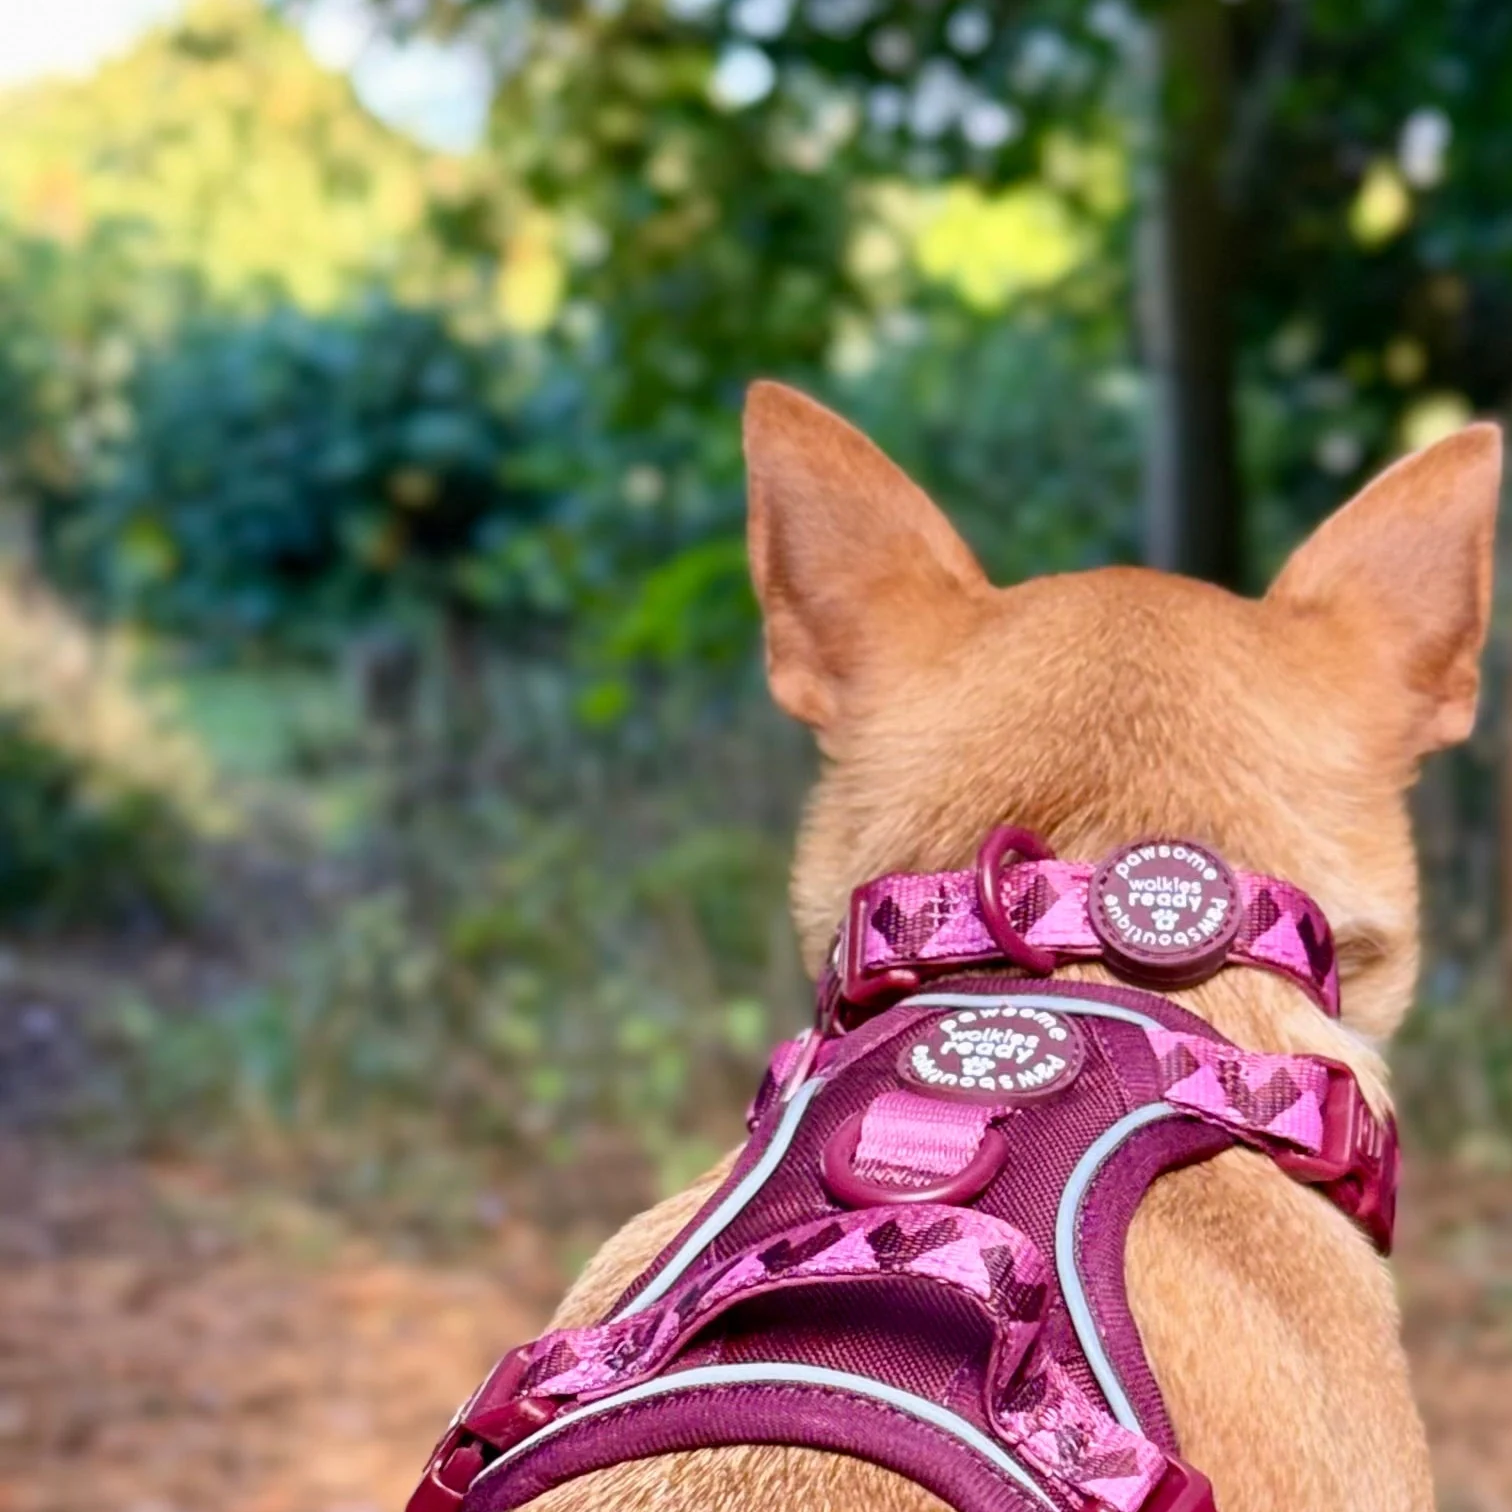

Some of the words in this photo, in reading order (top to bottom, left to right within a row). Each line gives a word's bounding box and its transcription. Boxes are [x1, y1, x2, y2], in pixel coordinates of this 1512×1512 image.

[1115, 845, 1218, 881] pawsome
[1128, 876, 1202, 893] walkies
[1128, 891, 1202, 912] ready
[940, 1008, 1067, 1041] pawsome
[949, 1028, 1040, 1049] walkies
[940, 1041, 1035, 1064] ready
